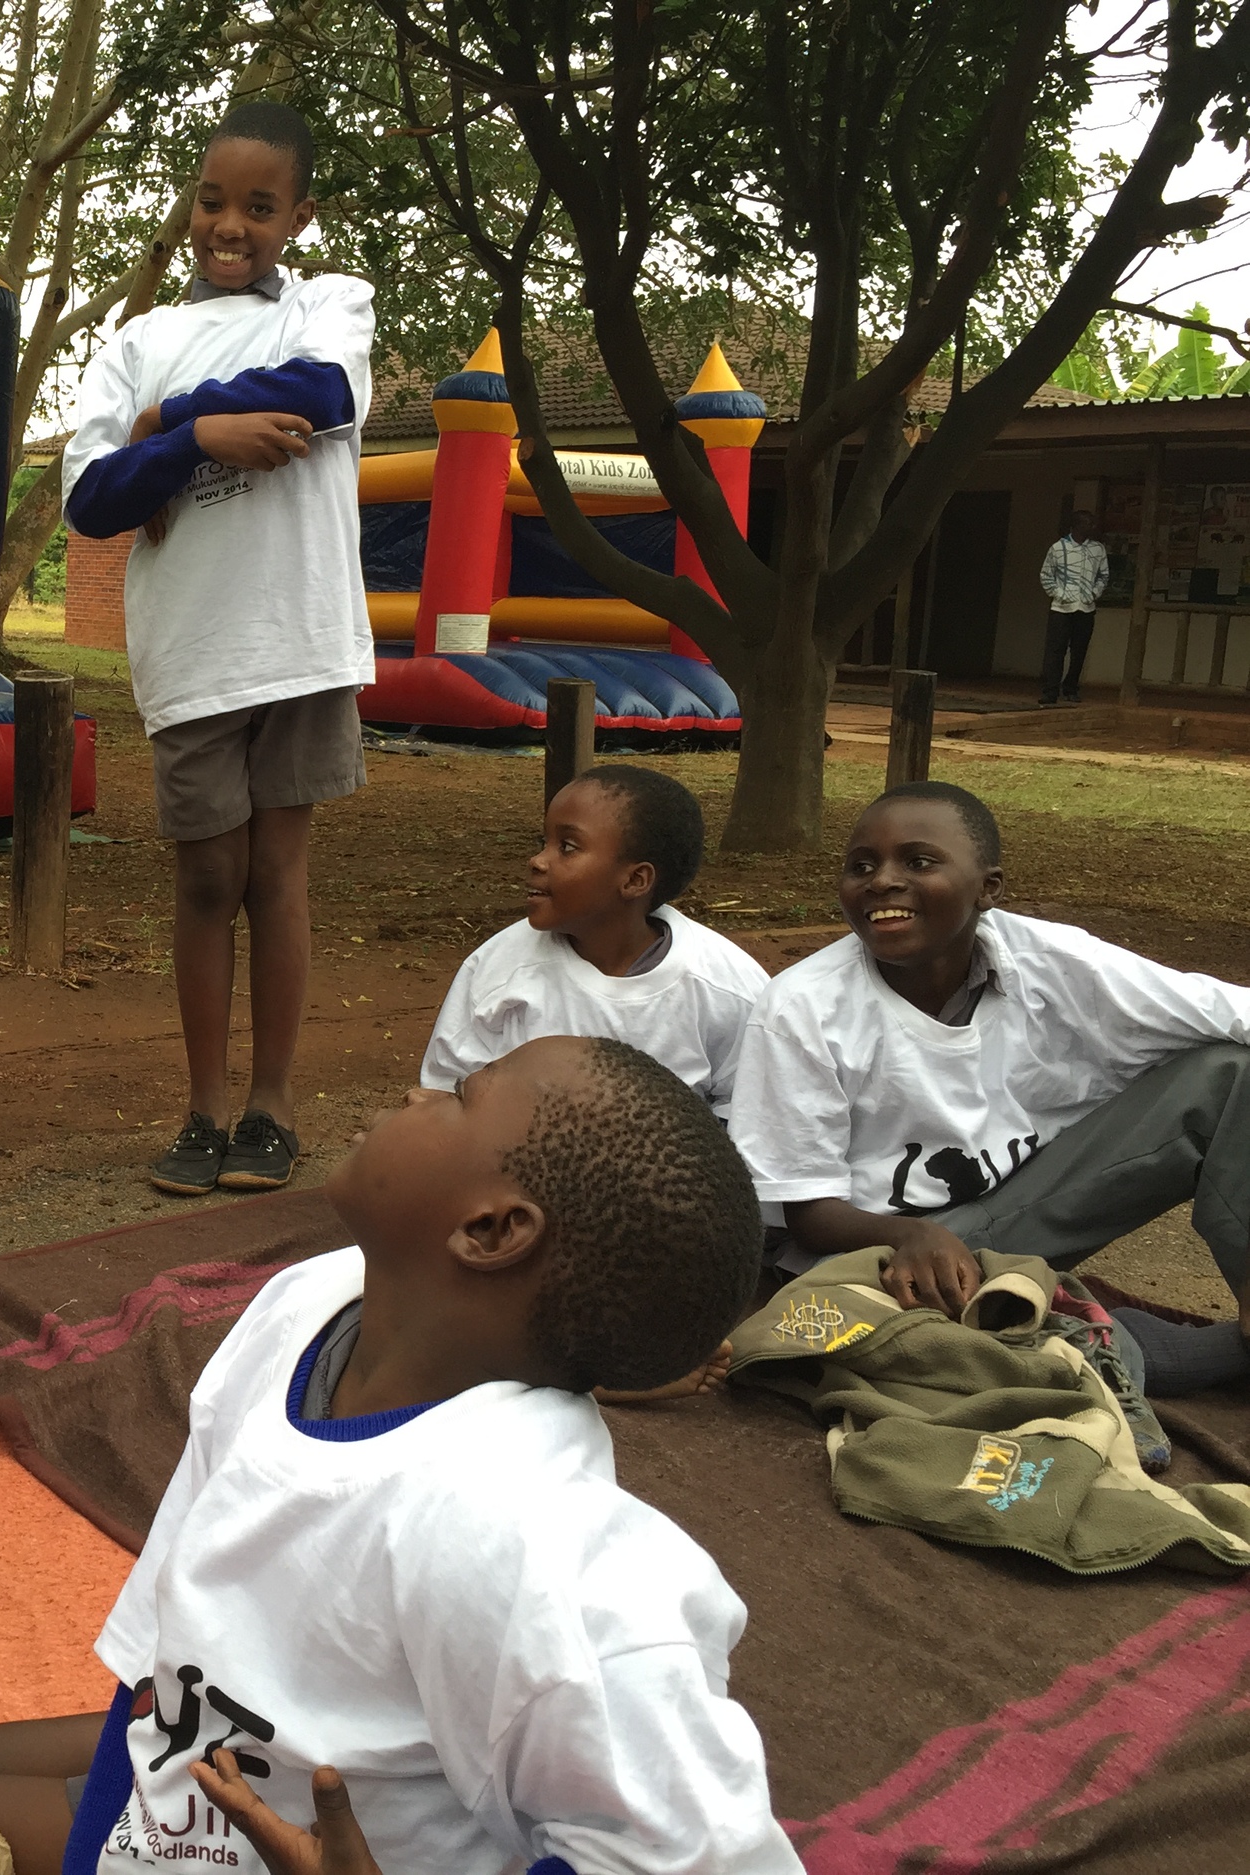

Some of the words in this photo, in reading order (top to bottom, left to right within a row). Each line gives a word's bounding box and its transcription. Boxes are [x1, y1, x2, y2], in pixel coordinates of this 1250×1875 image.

[556, 458, 585, 475] otal
[589, 459, 623, 477] Kids
[195, 490, 220, 503] NOV
[223, 481, 249, 496] 2014
